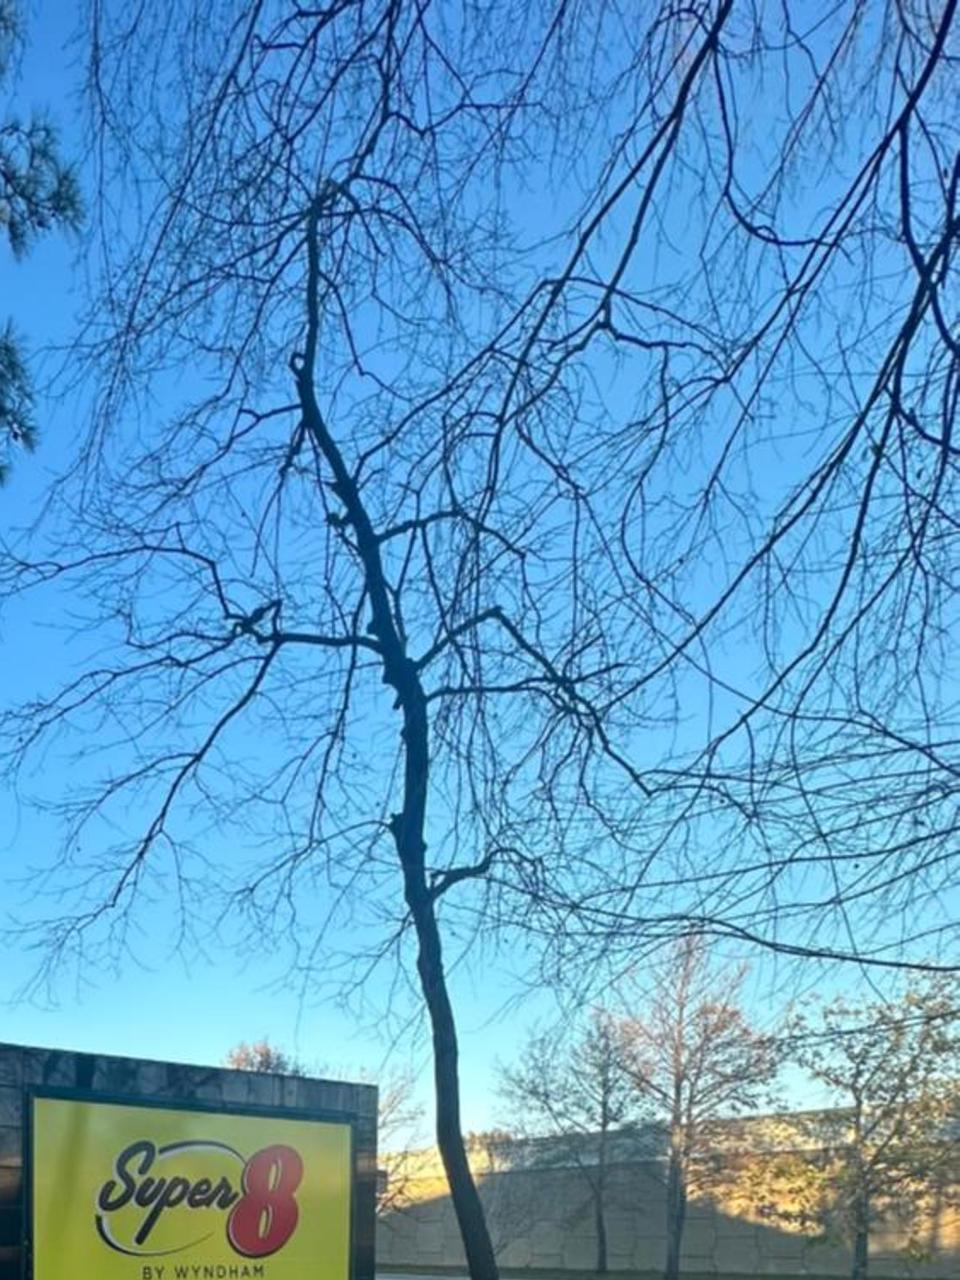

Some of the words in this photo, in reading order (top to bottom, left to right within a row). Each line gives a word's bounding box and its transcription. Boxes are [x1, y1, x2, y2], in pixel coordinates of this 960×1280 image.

[99, 1140, 238, 1245] Super
[227, 1144, 304, 1258] 8
[142, 1266, 165, 1280] BY
[174, 1265, 265, 1280] WYNDHAM
